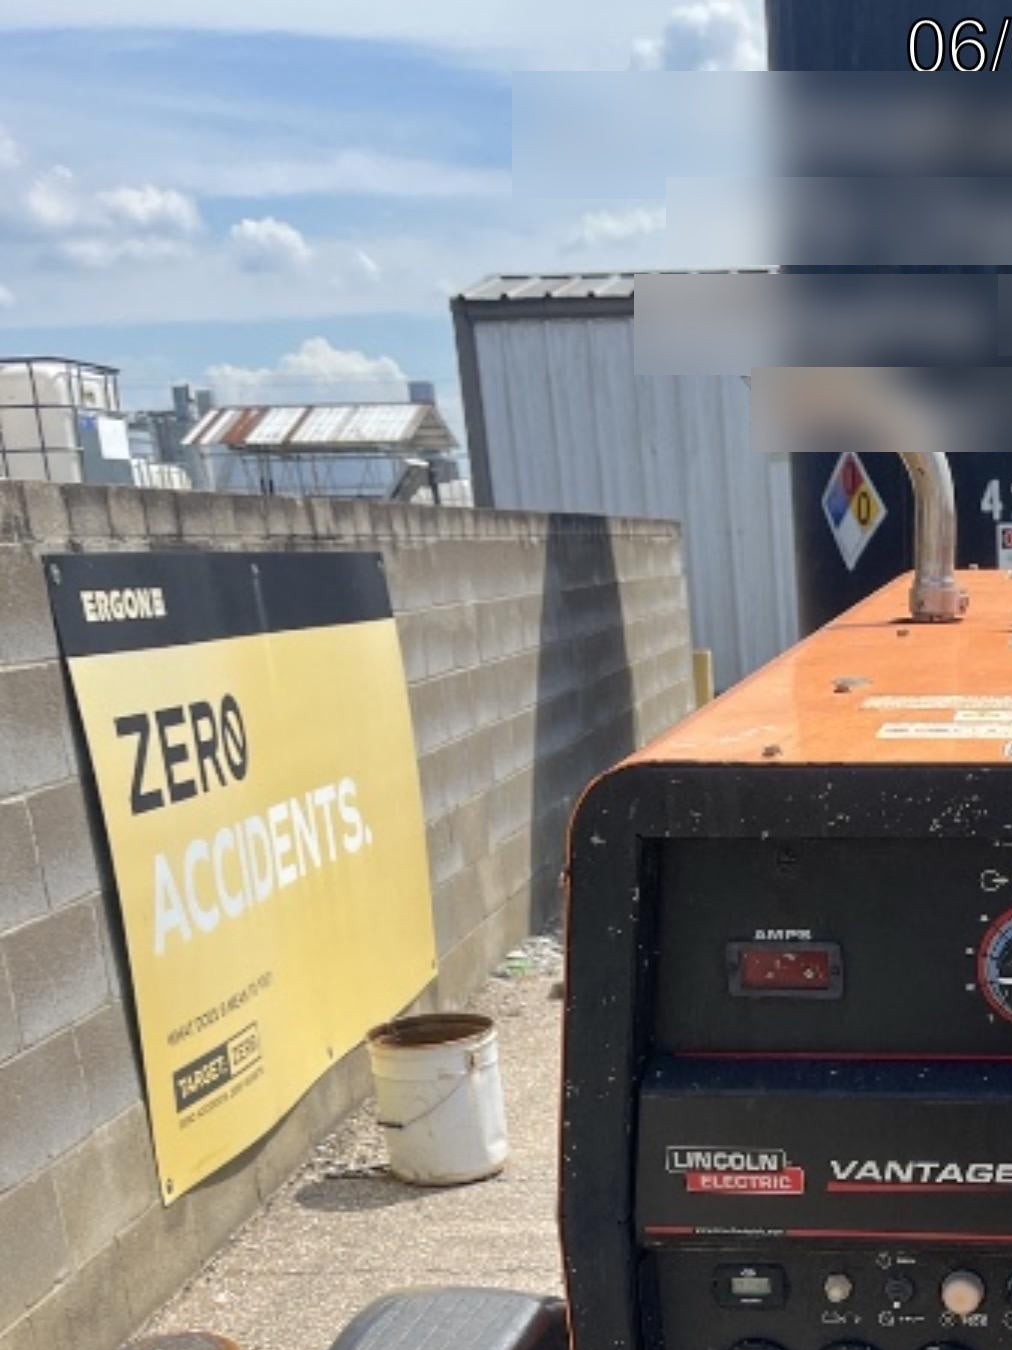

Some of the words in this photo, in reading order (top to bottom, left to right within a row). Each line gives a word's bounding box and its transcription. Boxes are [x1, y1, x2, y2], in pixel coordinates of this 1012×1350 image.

[114, 693, 248, 815] ZERO
[152, 776, 373, 956] ACCIDENTS.
[755, 929, 811, 940] AMPS
[674, 1151, 778, 1171] LINCOLN
[701, 1175, 792, 1189] ELECTRIC
